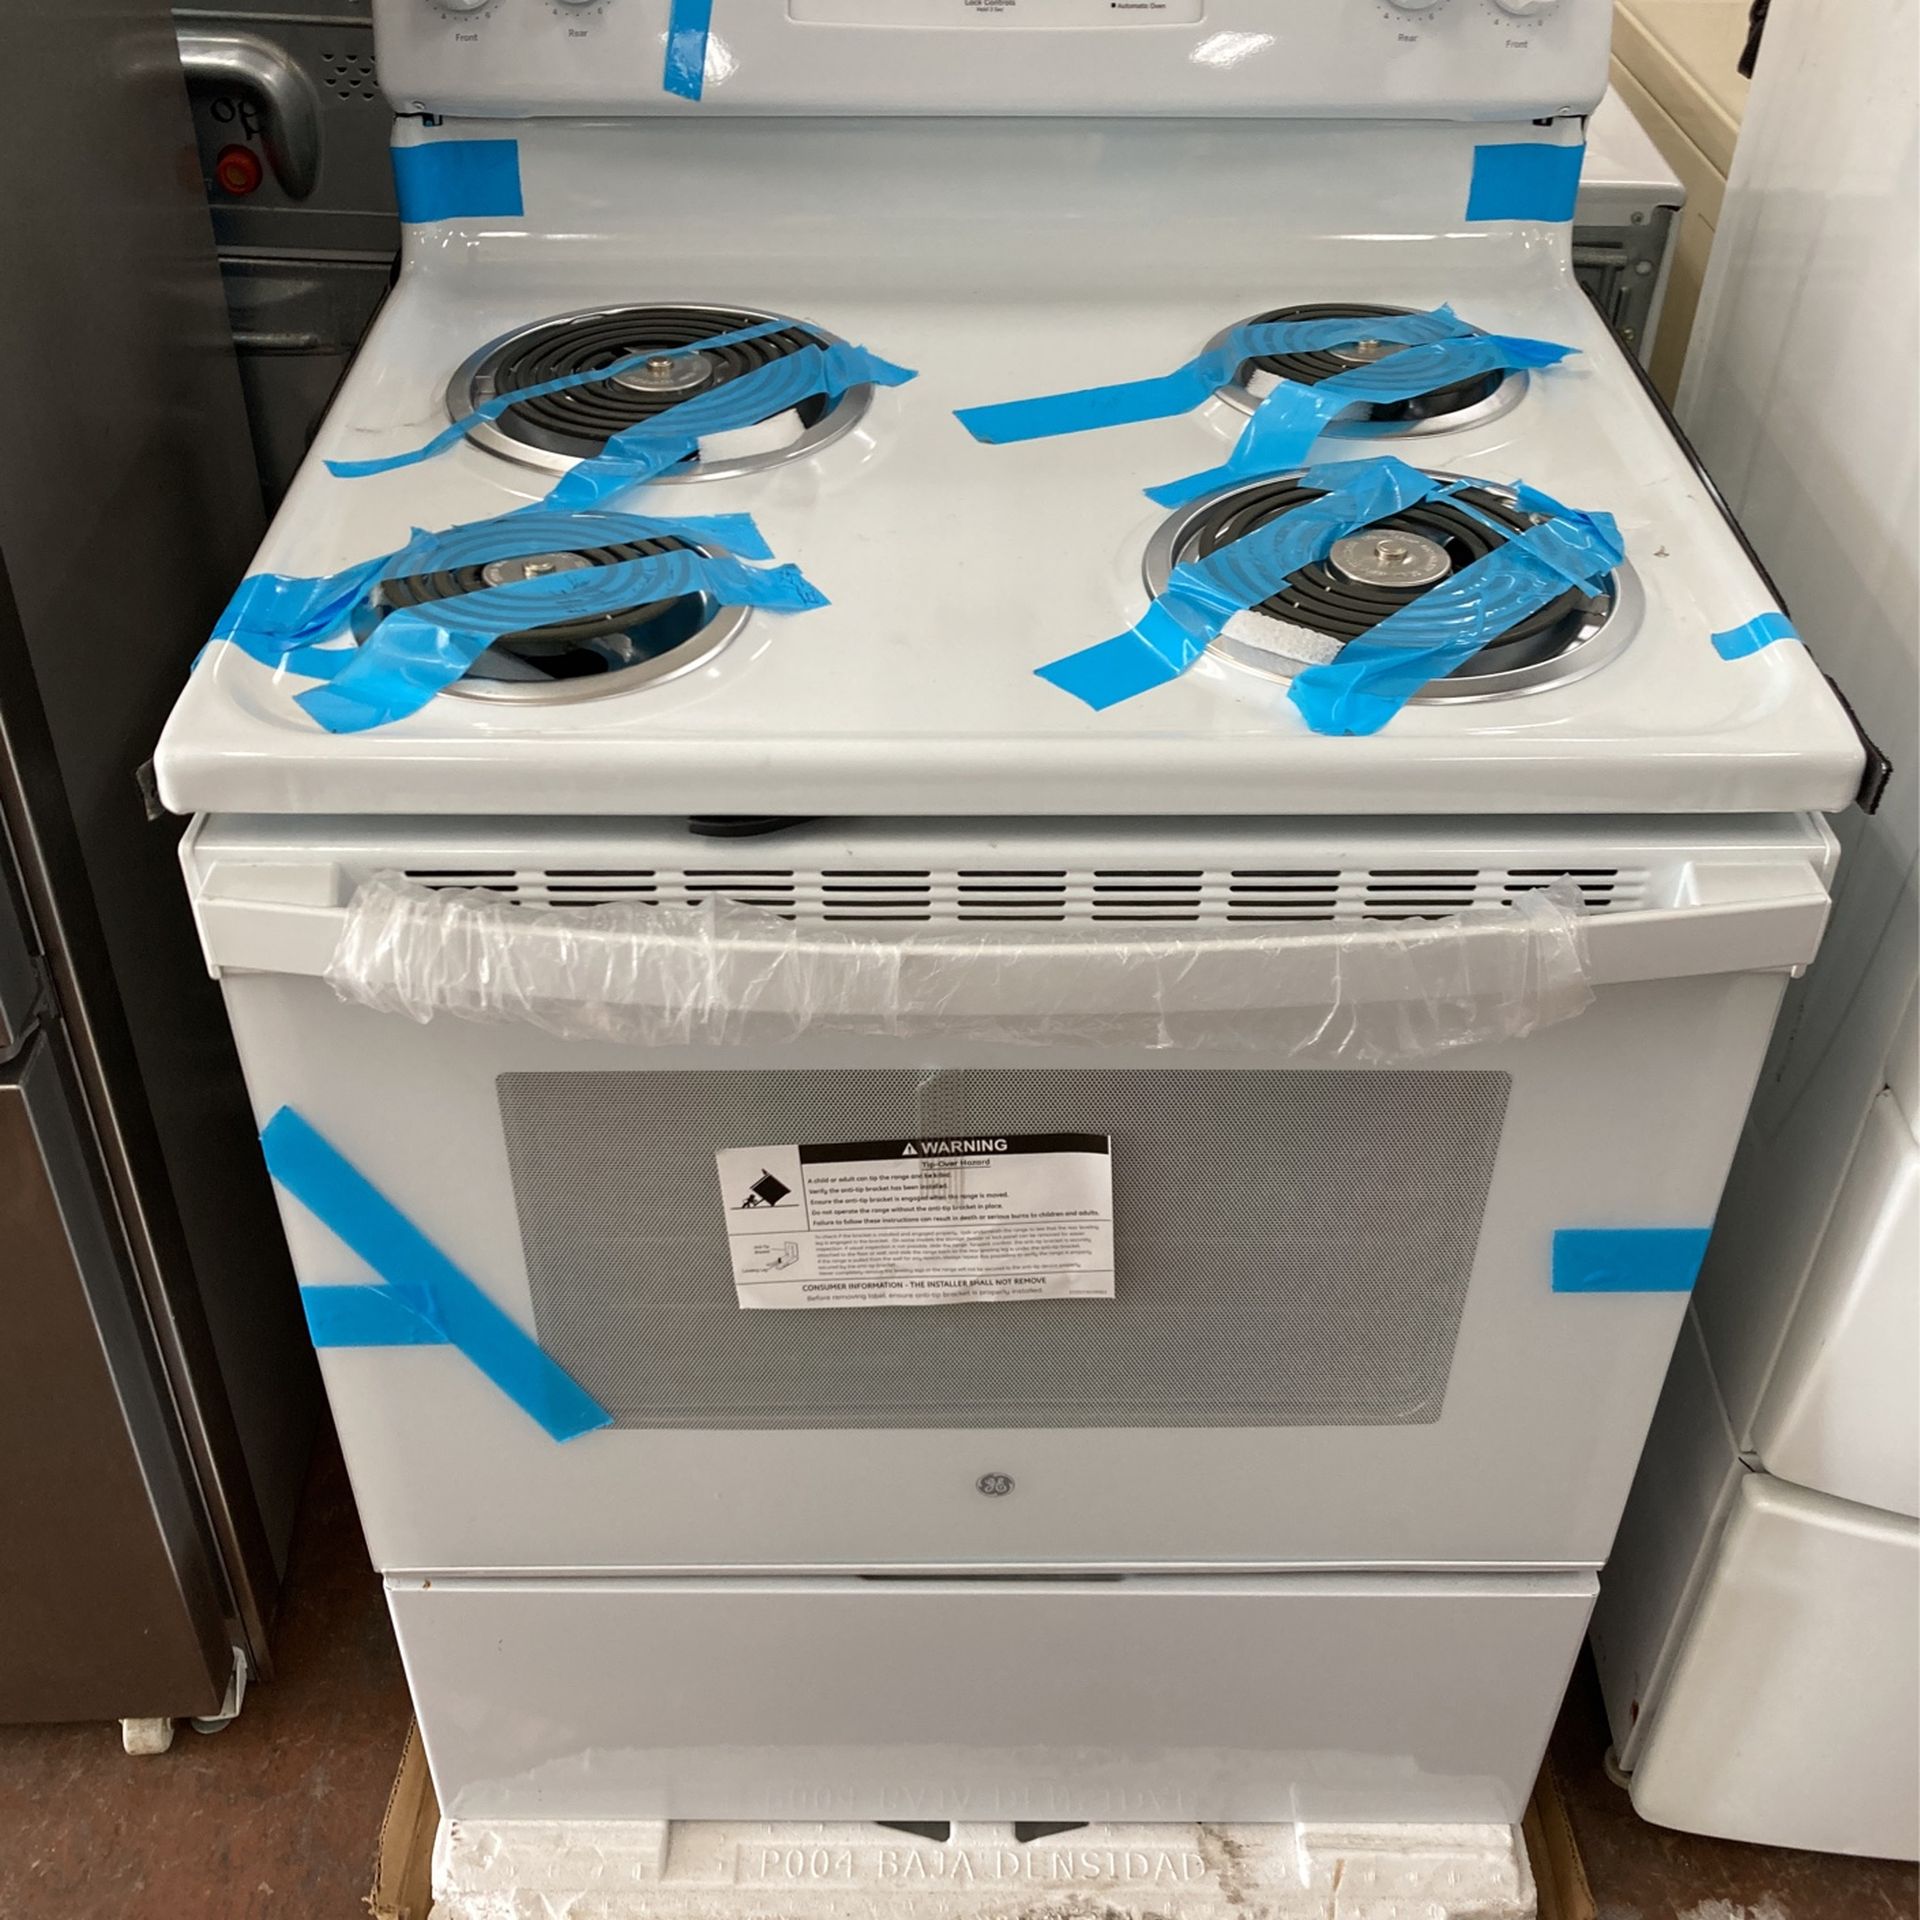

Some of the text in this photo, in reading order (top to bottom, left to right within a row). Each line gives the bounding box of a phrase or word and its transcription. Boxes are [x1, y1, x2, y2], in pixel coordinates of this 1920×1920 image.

[455, 33, 479, 42] Front
[568, 29, 588, 37] Rear
[1397, 33, 1419, 42] Rear
[1505, 40, 1528, 49] Front
[921, 1138, 1008, 1155] WARNING
[922, 1158, 991, 1169] Tip-Over Hazard
[869, 1175, 877, 1183] tip
[901, 1194, 929, 1202] engaged
[834, 1208, 859, 1216] operate
[802, 1283, 847, 1292] CONSUMER
[848, 1281, 903, 1290] INFORMATION
[927, 1280, 970, 1288] INSTALLER
[970, 1278, 993, 1287] SHALL
[995, 1278, 1012, 1286] NOT
[1013, 1277, 1047, 1285] REMOVE
[979, 1288, 1010, 1296] properly
[759, 1849, 1207, 1881] P004 BAJA DENSIDAD
